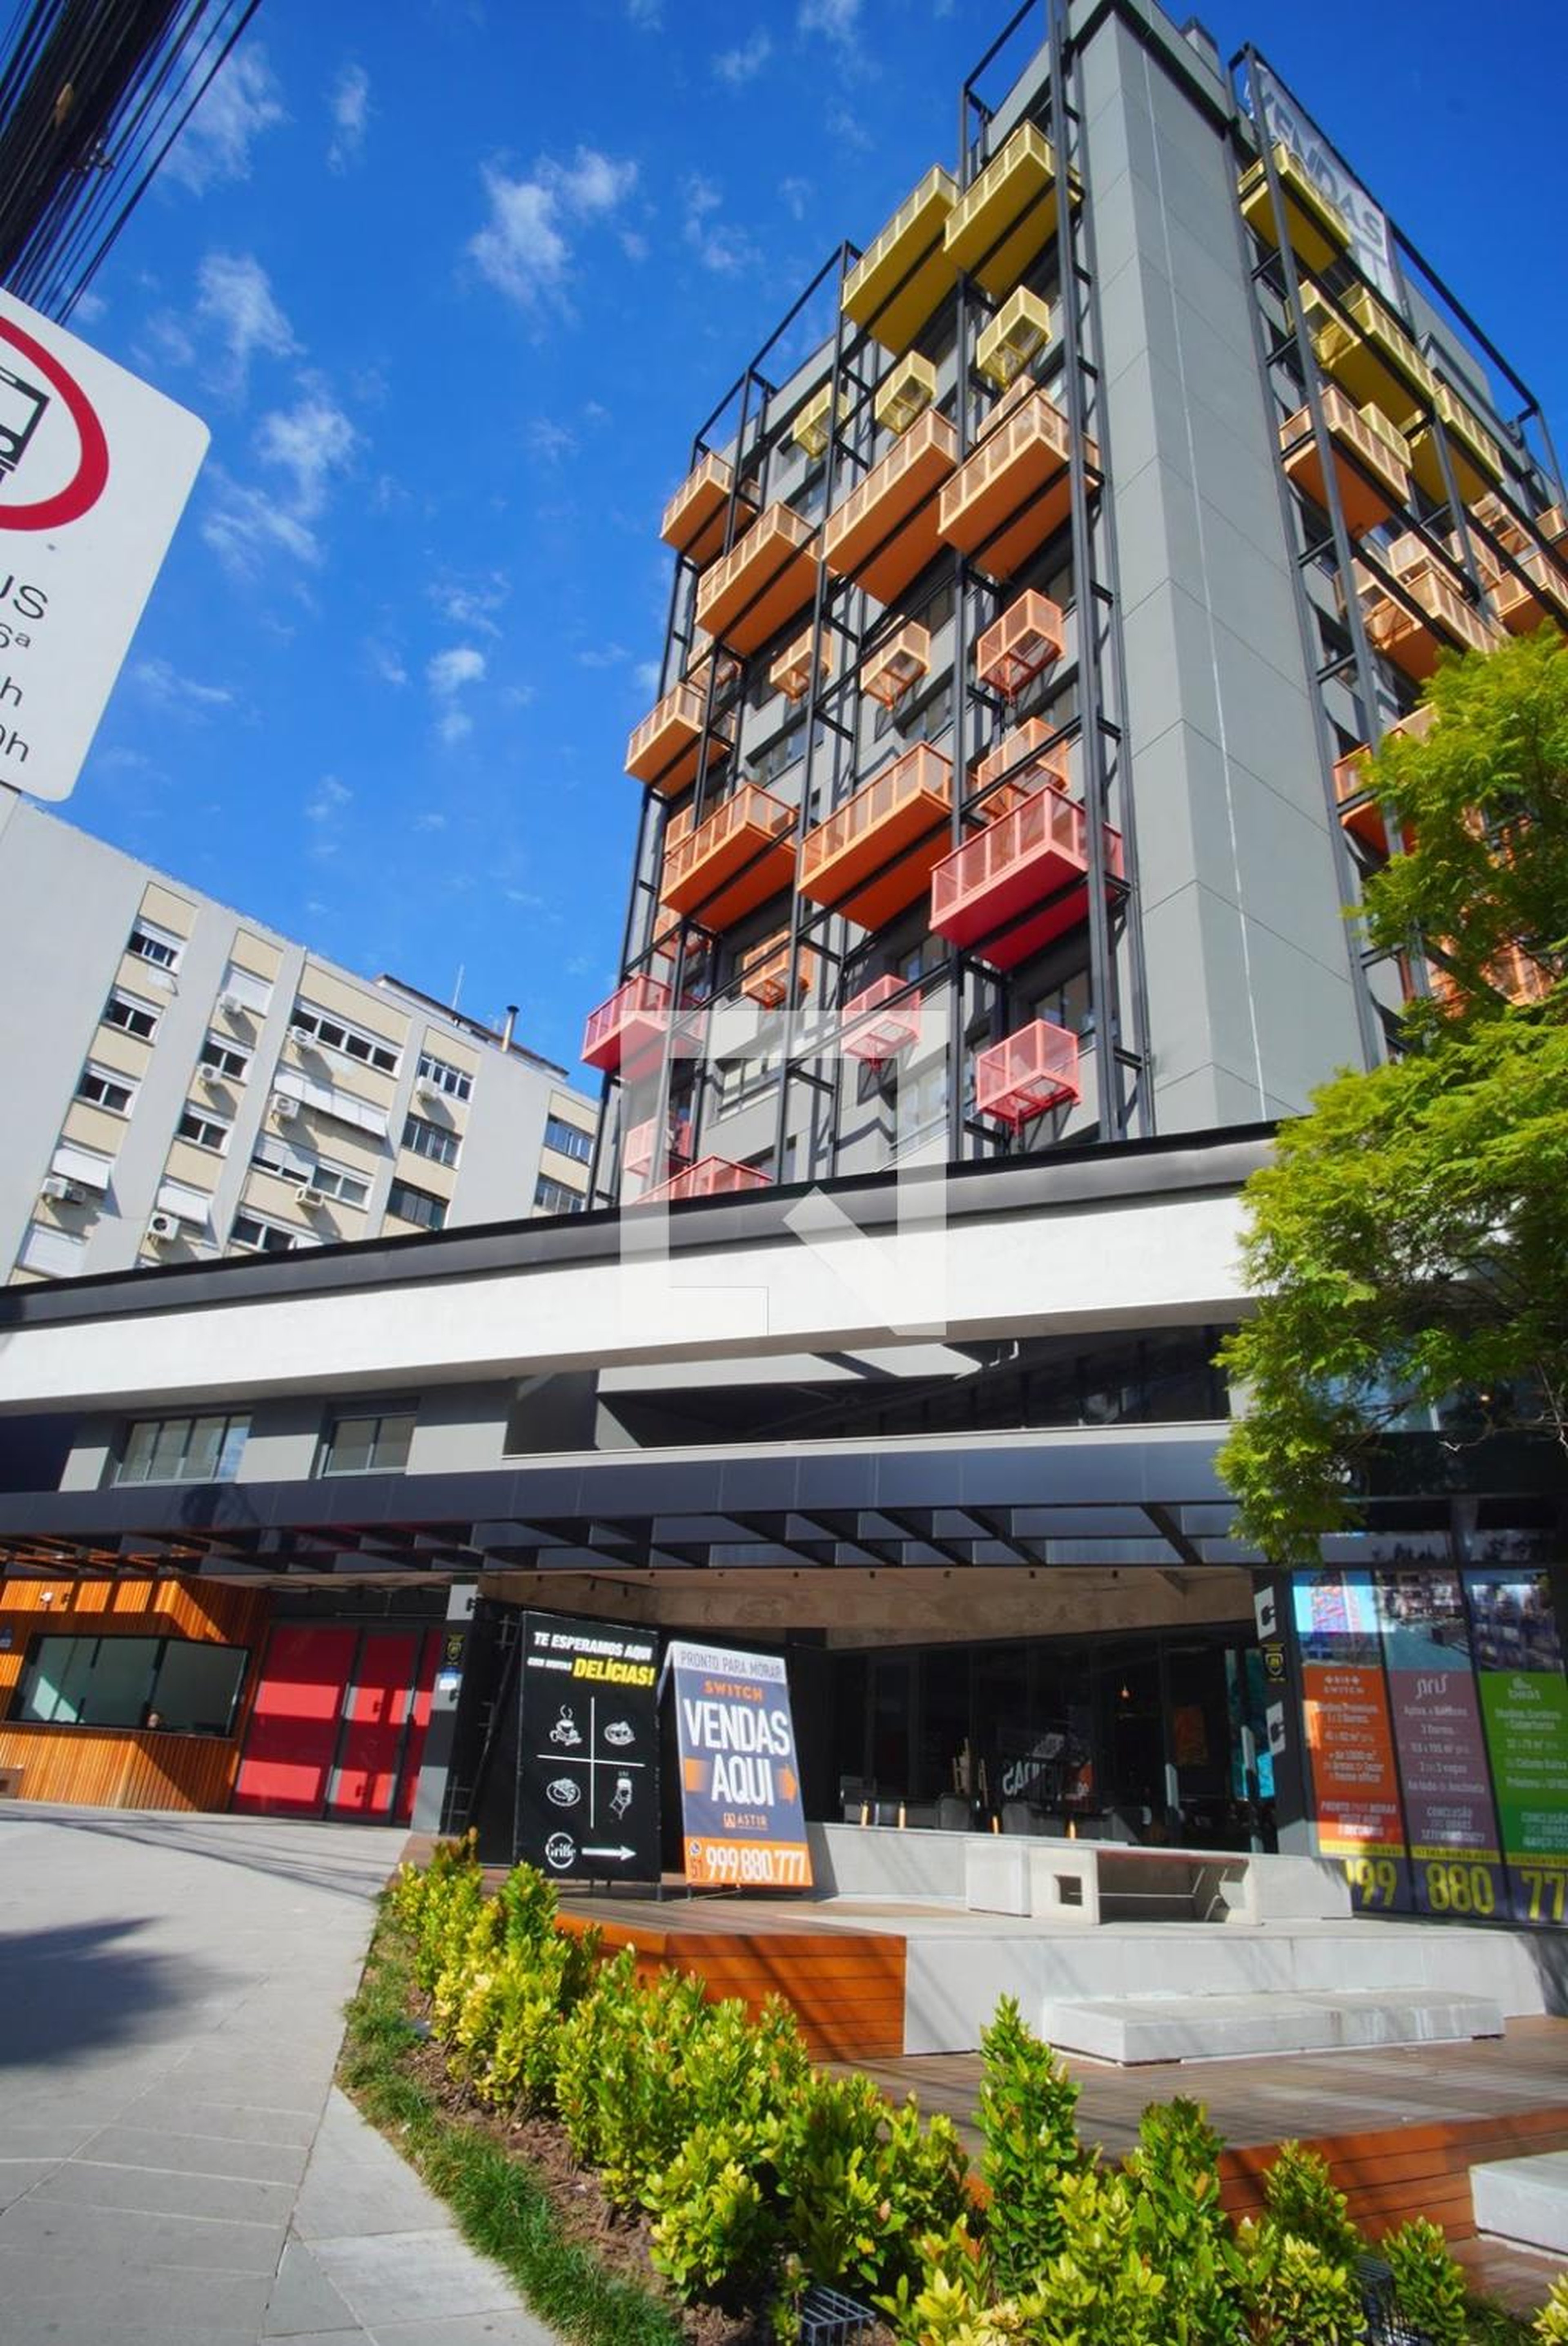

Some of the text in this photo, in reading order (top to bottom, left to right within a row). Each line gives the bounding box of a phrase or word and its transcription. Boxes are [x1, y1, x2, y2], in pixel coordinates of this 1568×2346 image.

[534, 1632, 550, 1646] TE
[551, 1634, 624, 1656] ESPERAMOS
[573, 1656, 655, 1686] DELÍCIAS!
[681, 1650, 719, 1670] PRONTO
[722, 1656, 746, 1674] PARA
[703, 1679, 763, 1702] SWITCH
[683, 1698, 791, 1756] VENDAS
[710, 1753, 775, 1807] AQUI
[1426, 1863, 1495, 1914] 880
